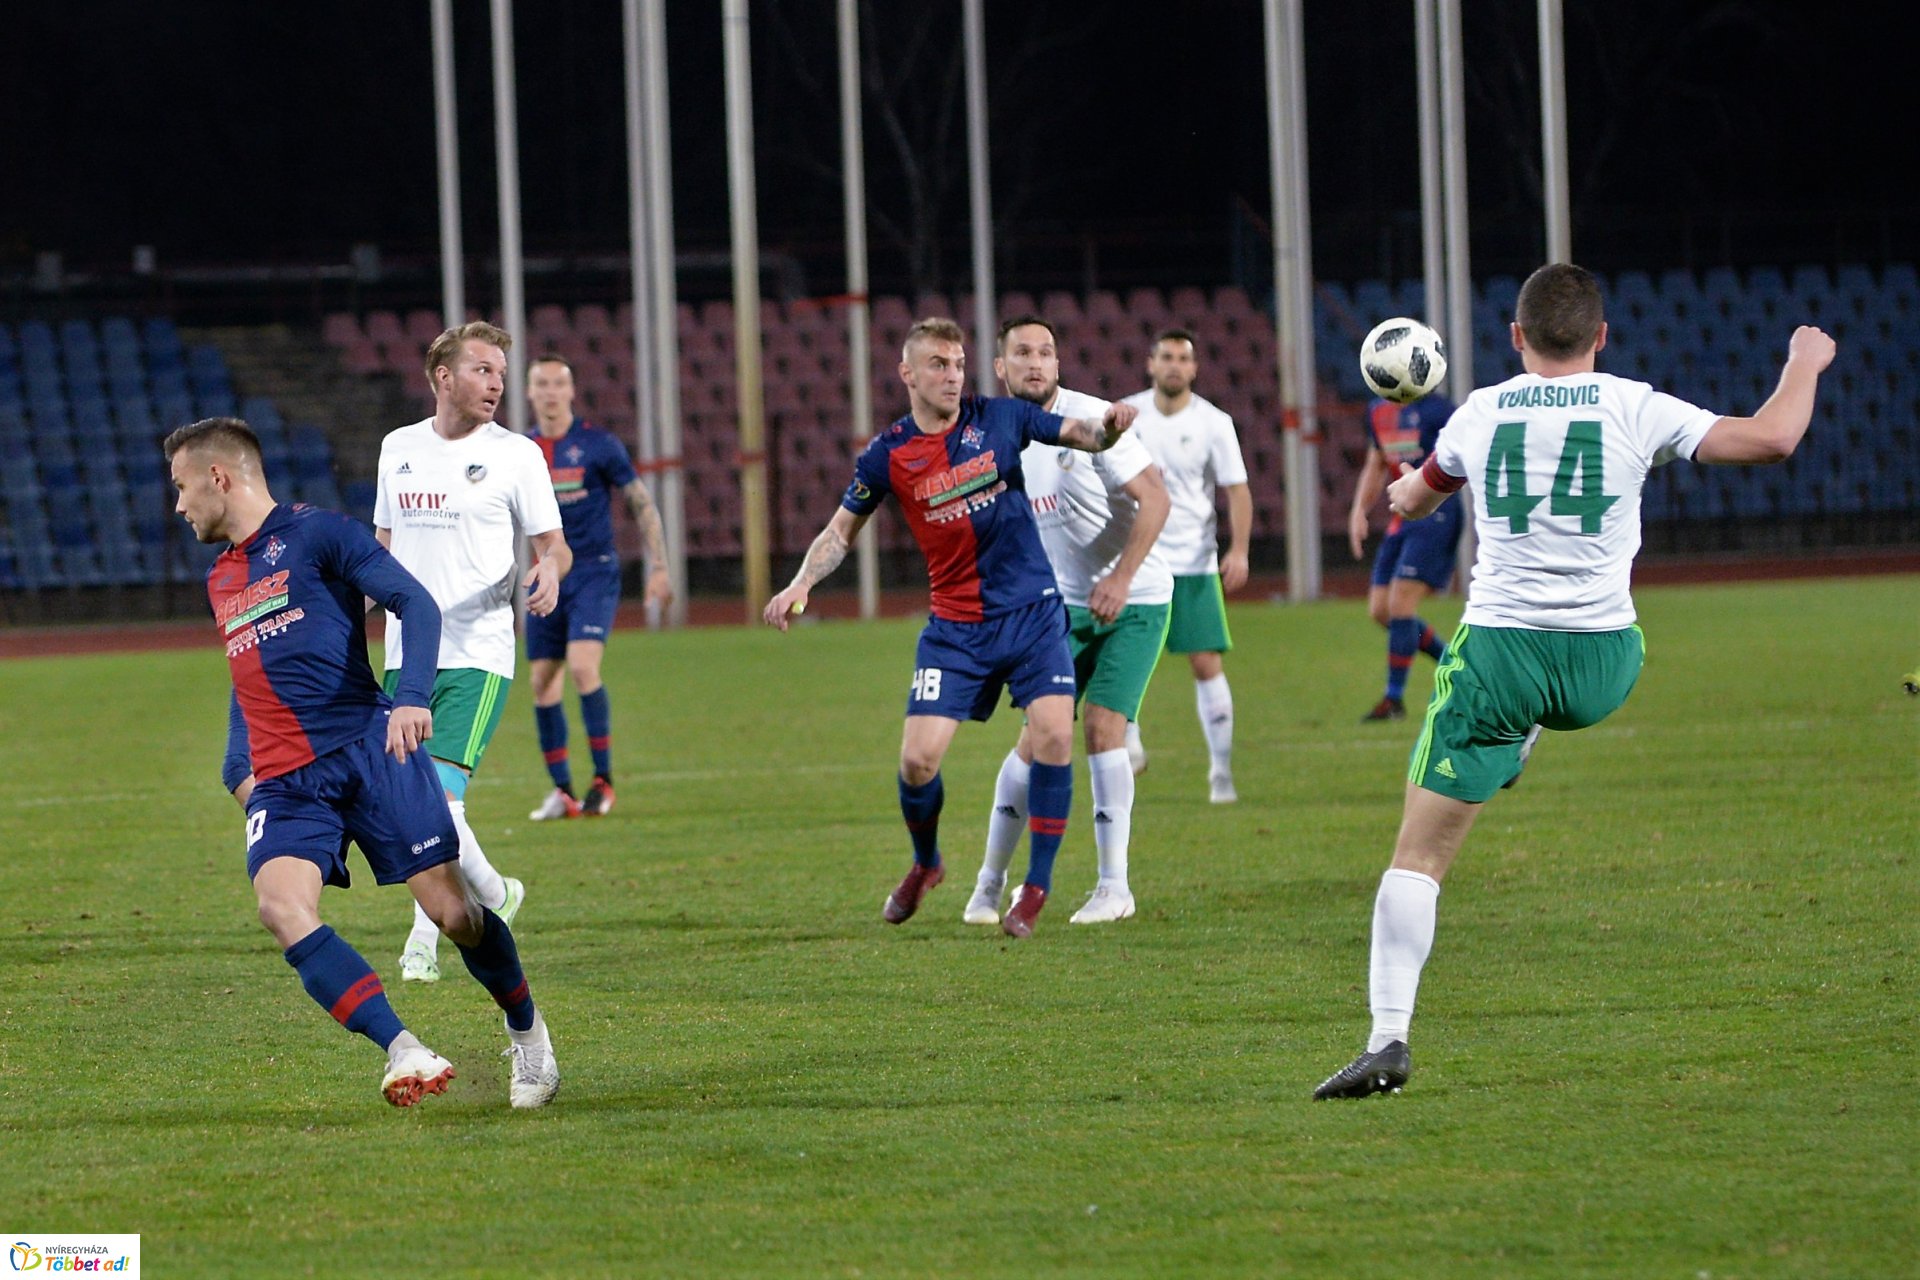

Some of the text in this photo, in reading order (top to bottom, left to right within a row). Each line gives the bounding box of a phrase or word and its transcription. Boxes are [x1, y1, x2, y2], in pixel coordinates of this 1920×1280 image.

[1498, 384, 1600, 409] VUKASOVIC
[1485, 420, 1622, 535] 44
[402, 506, 461, 520] automotive
[257, 607, 305, 635] TRANS
[912, 667, 943, 702] 48
[423, 835, 441, 850] JAKO
